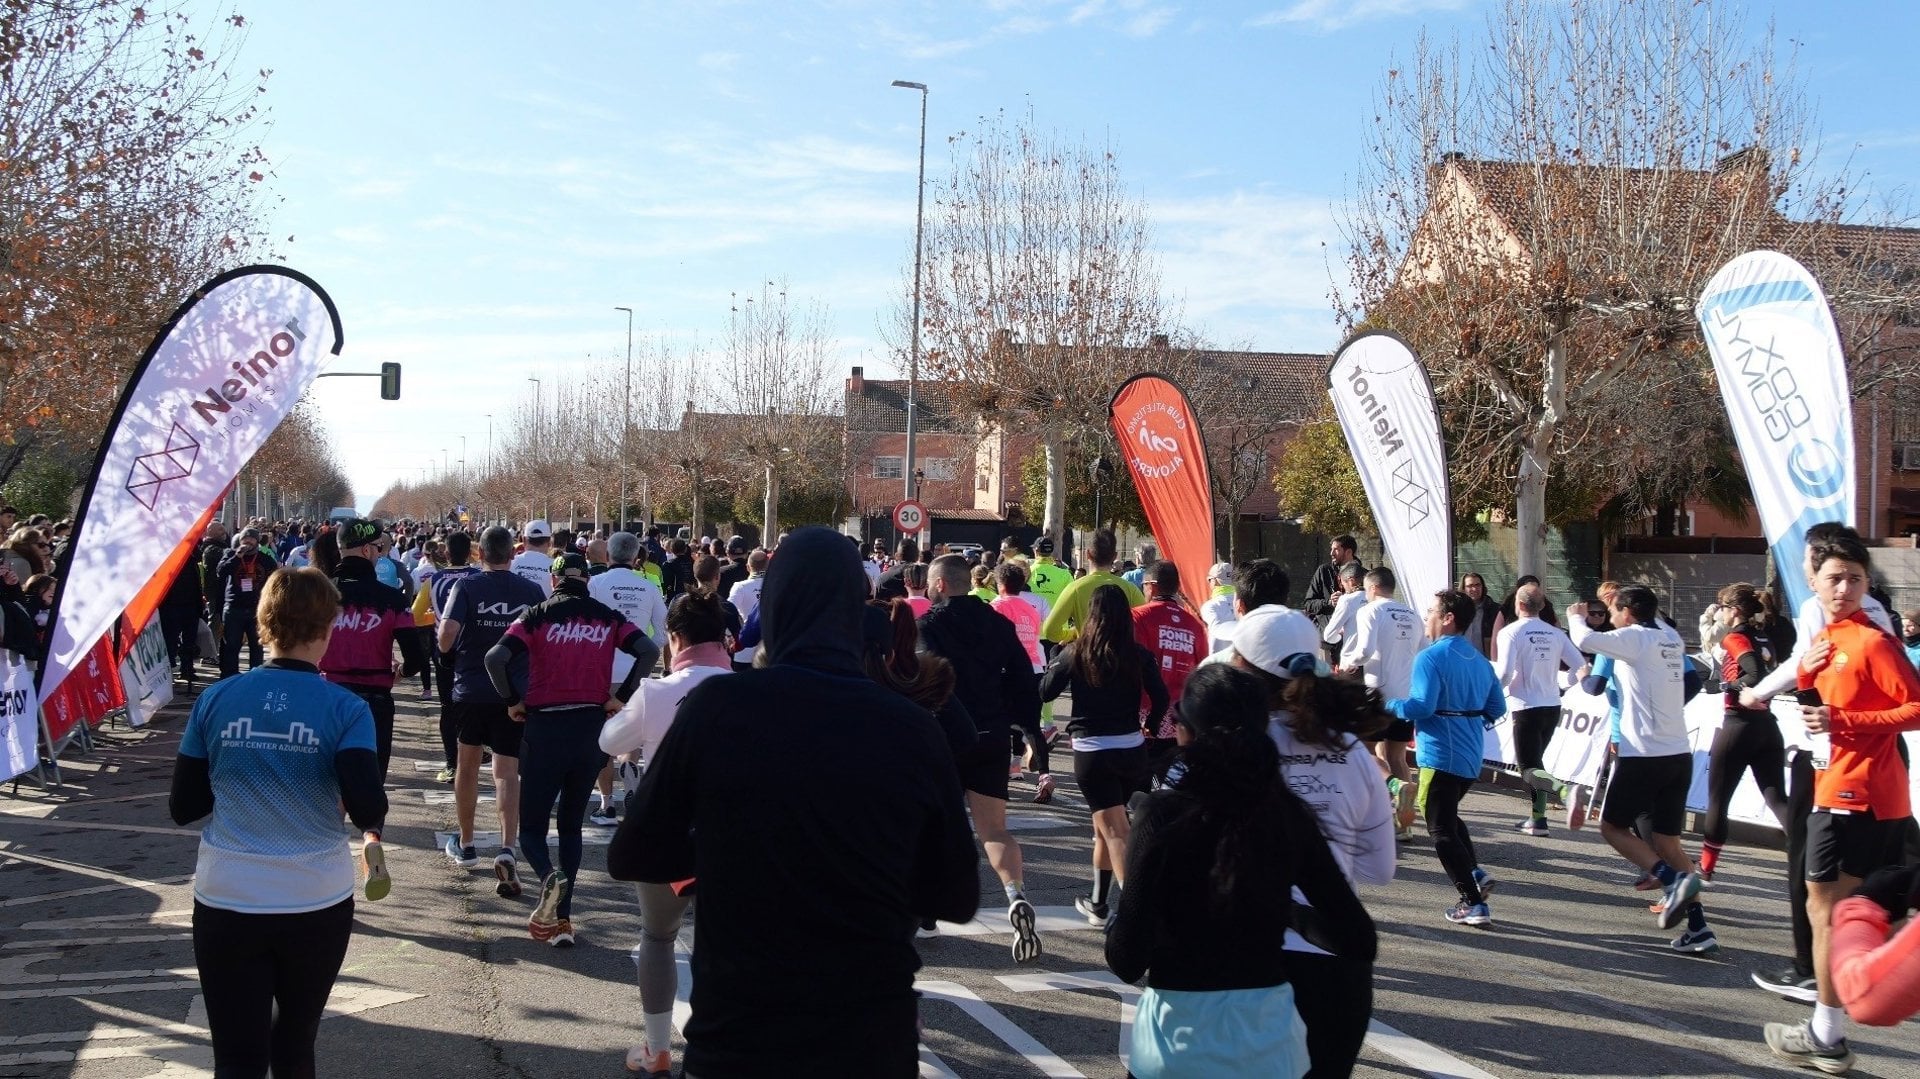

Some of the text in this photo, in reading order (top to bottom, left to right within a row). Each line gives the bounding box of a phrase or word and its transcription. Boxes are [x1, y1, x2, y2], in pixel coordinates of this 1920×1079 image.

[191, 316, 308, 427] Neinor
[219, 384, 278, 440] HOMES
[900, 510, 919, 523] 30
[546, 621, 611, 650] CHARLY
[1158, 629, 1196, 645] PONLE
[1158, 639, 1195, 655] FRENO
[222, 739, 319, 754] SPORT CENTER AZUQUECA
